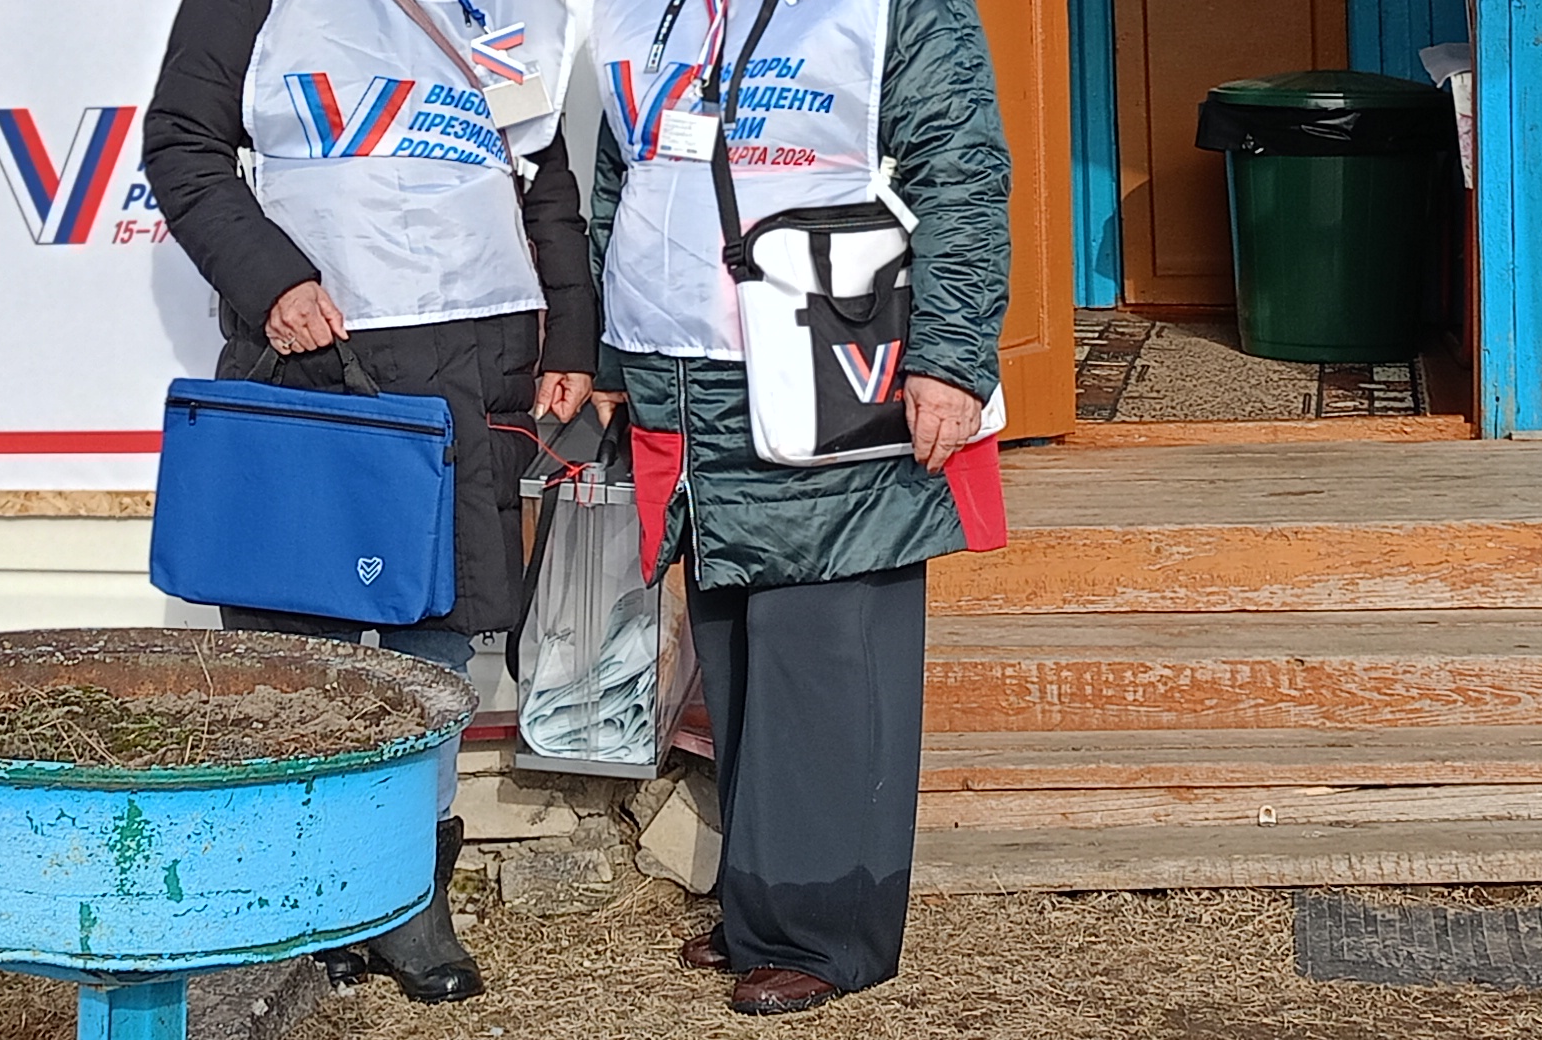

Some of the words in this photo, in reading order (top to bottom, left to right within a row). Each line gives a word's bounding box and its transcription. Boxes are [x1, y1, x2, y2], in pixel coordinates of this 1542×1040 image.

[424, 84, 491, 119] ВЫБО
[721, 86, 834, 113] ИДЕНТА
[771, 147, 816, 166] 2024
